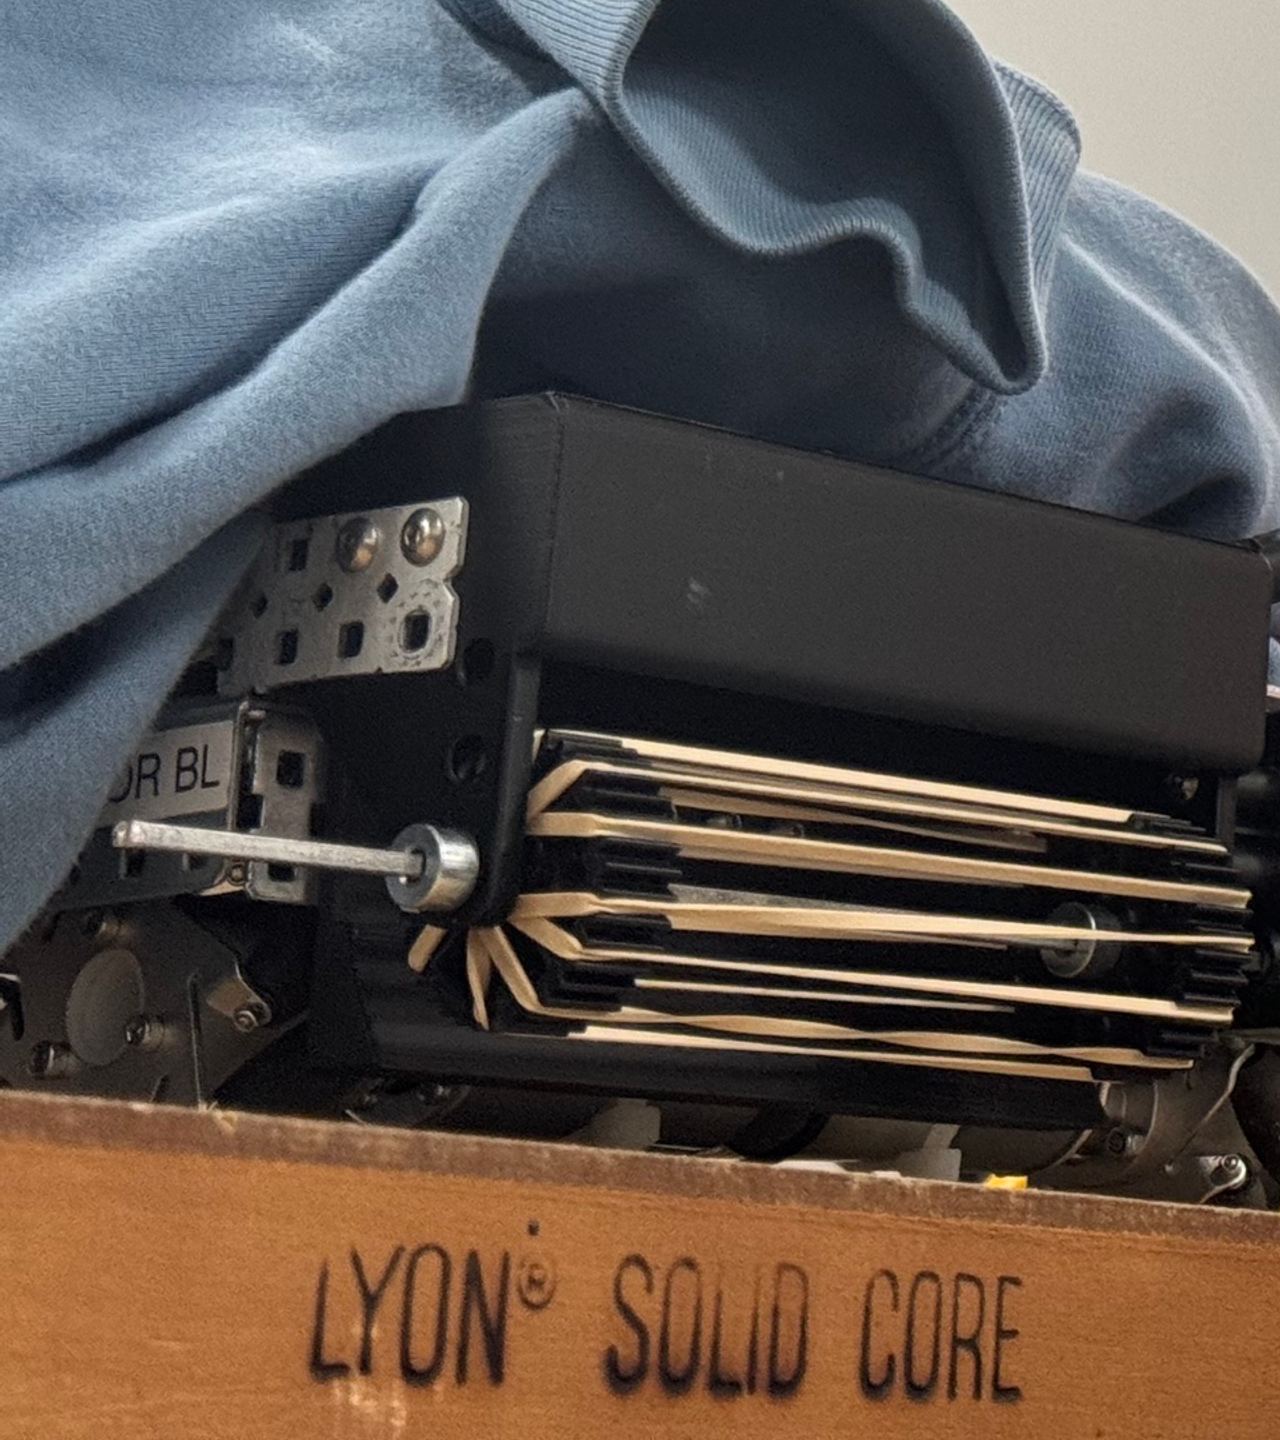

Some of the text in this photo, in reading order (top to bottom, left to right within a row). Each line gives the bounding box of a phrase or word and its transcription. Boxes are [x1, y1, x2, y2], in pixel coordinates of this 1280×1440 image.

[175, 744, 220, 793] BL
[603, 1254, 810, 1396] SOLID
[860, 1267, 1023, 1402] CORE
